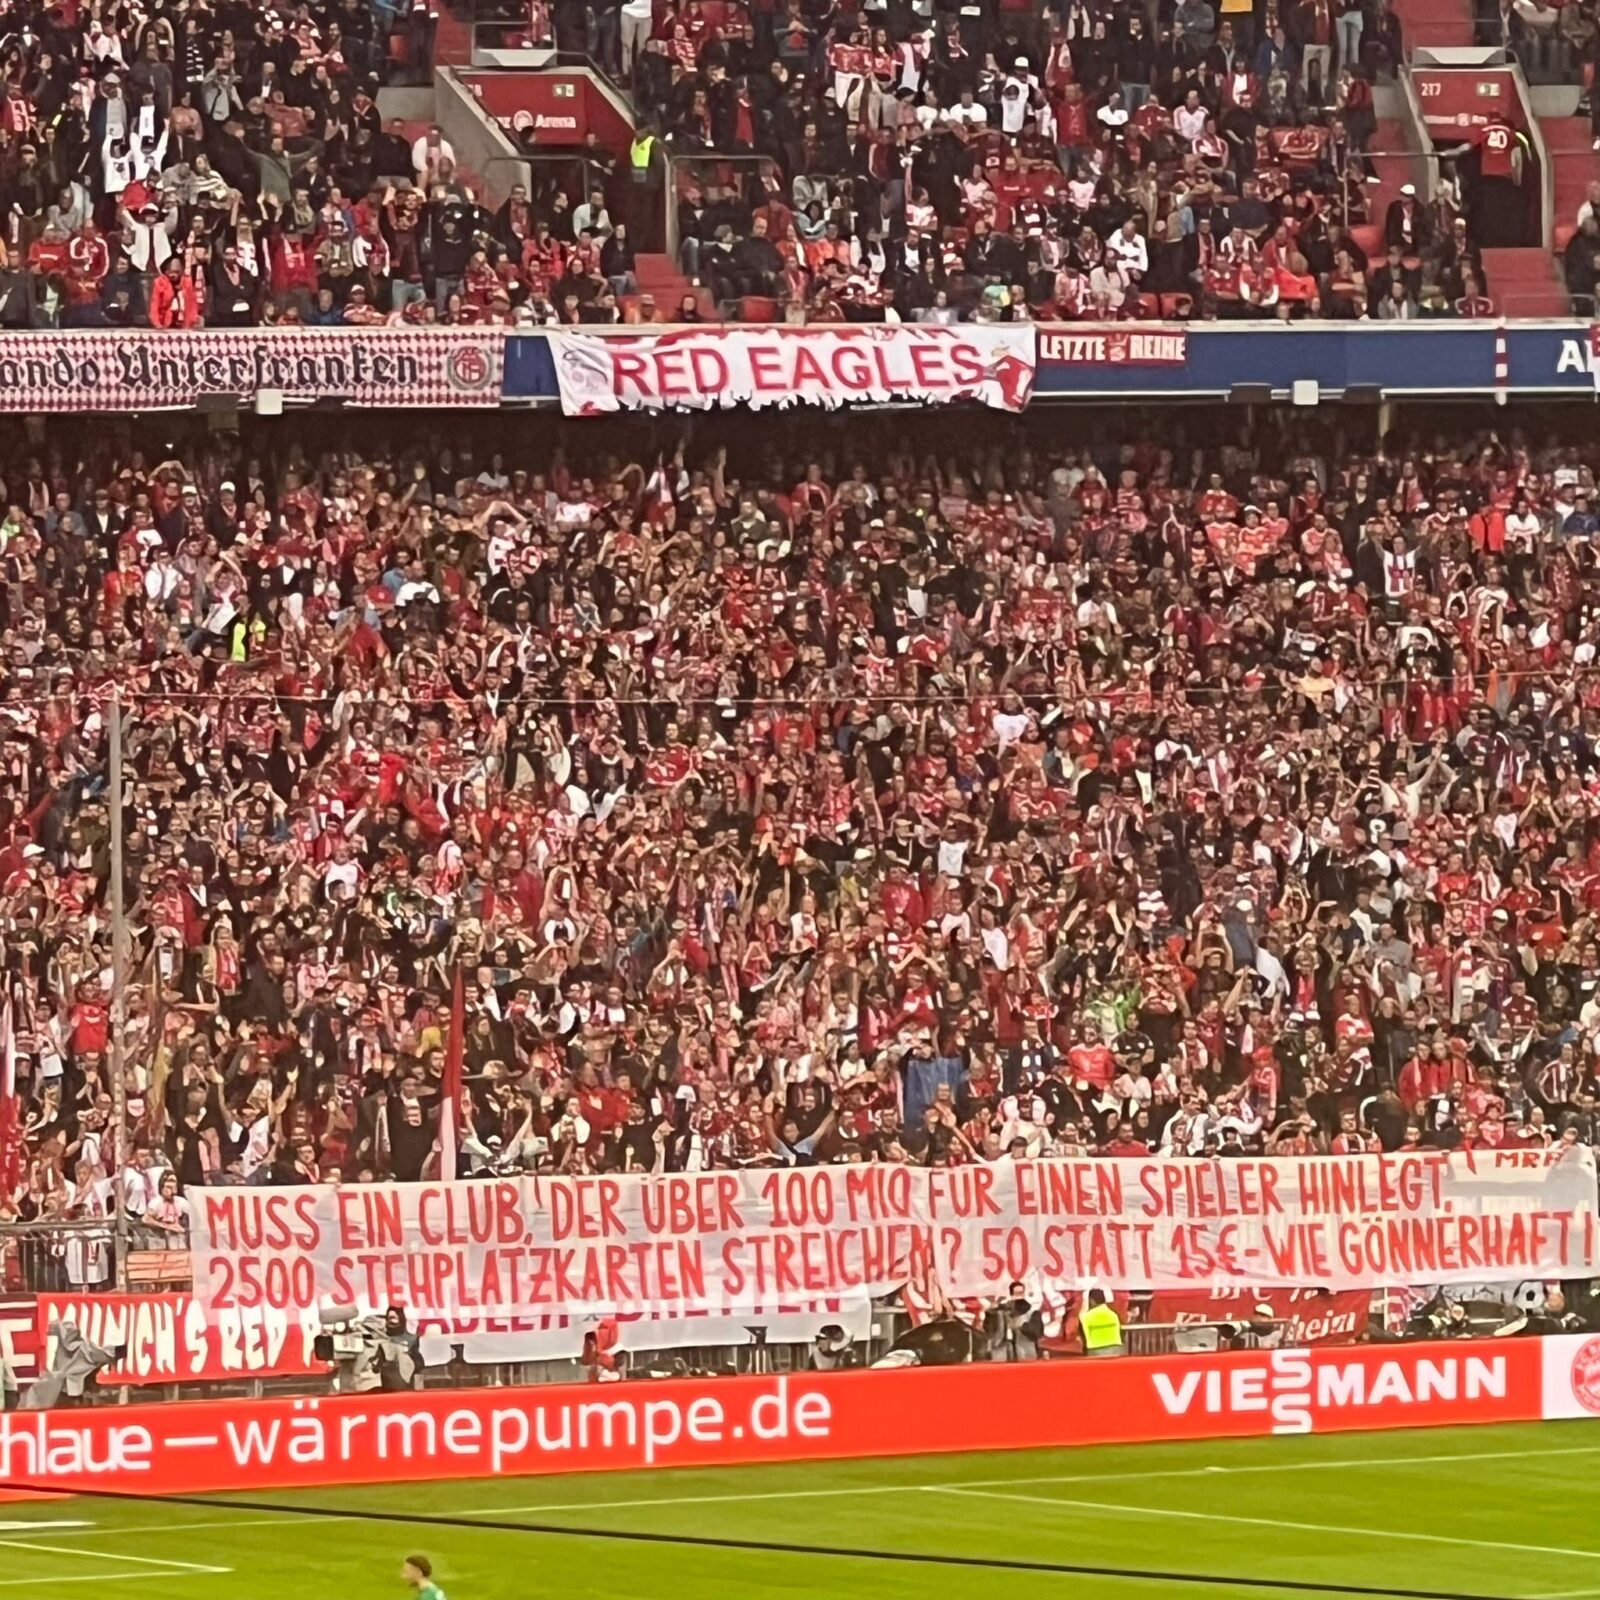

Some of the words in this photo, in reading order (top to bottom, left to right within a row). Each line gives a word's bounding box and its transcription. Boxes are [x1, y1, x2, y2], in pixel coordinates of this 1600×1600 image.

[612, 349, 728, 396] RED
[747, 344, 986, 391] EAGLES
[1040, 334, 1106, 361] LETZTE
[1129, 334, 1186, 361] REIHE
[206, 1193, 320, 1251] MUSS
[337, 1190, 403, 1250] EIN
[419, 1182, 533, 1246] CLUB,
[551, 1179, 627, 1242] DER
[641, 1176, 745, 1235] ÜBER
[761, 1170, 835, 1228] 100
[845, 1166, 912, 1222] MIO
[1014, 1162, 1124, 1216] EINEN
[1139, 1161, 1285, 1218] SPIELER
[1298, 1154, 1453, 1216] HINLEGT.
[209, 1255, 315, 1310] 2500
[331, 1239, 706, 1310] STEHPLATZKARTEN
[982, 1225, 1030, 1281] 50
[1042, 1223, 1155, 1280] STATT
[218, 1296, 288, 1372] RED
[1151, 1348, 1508, 1435] VIESSMANN
